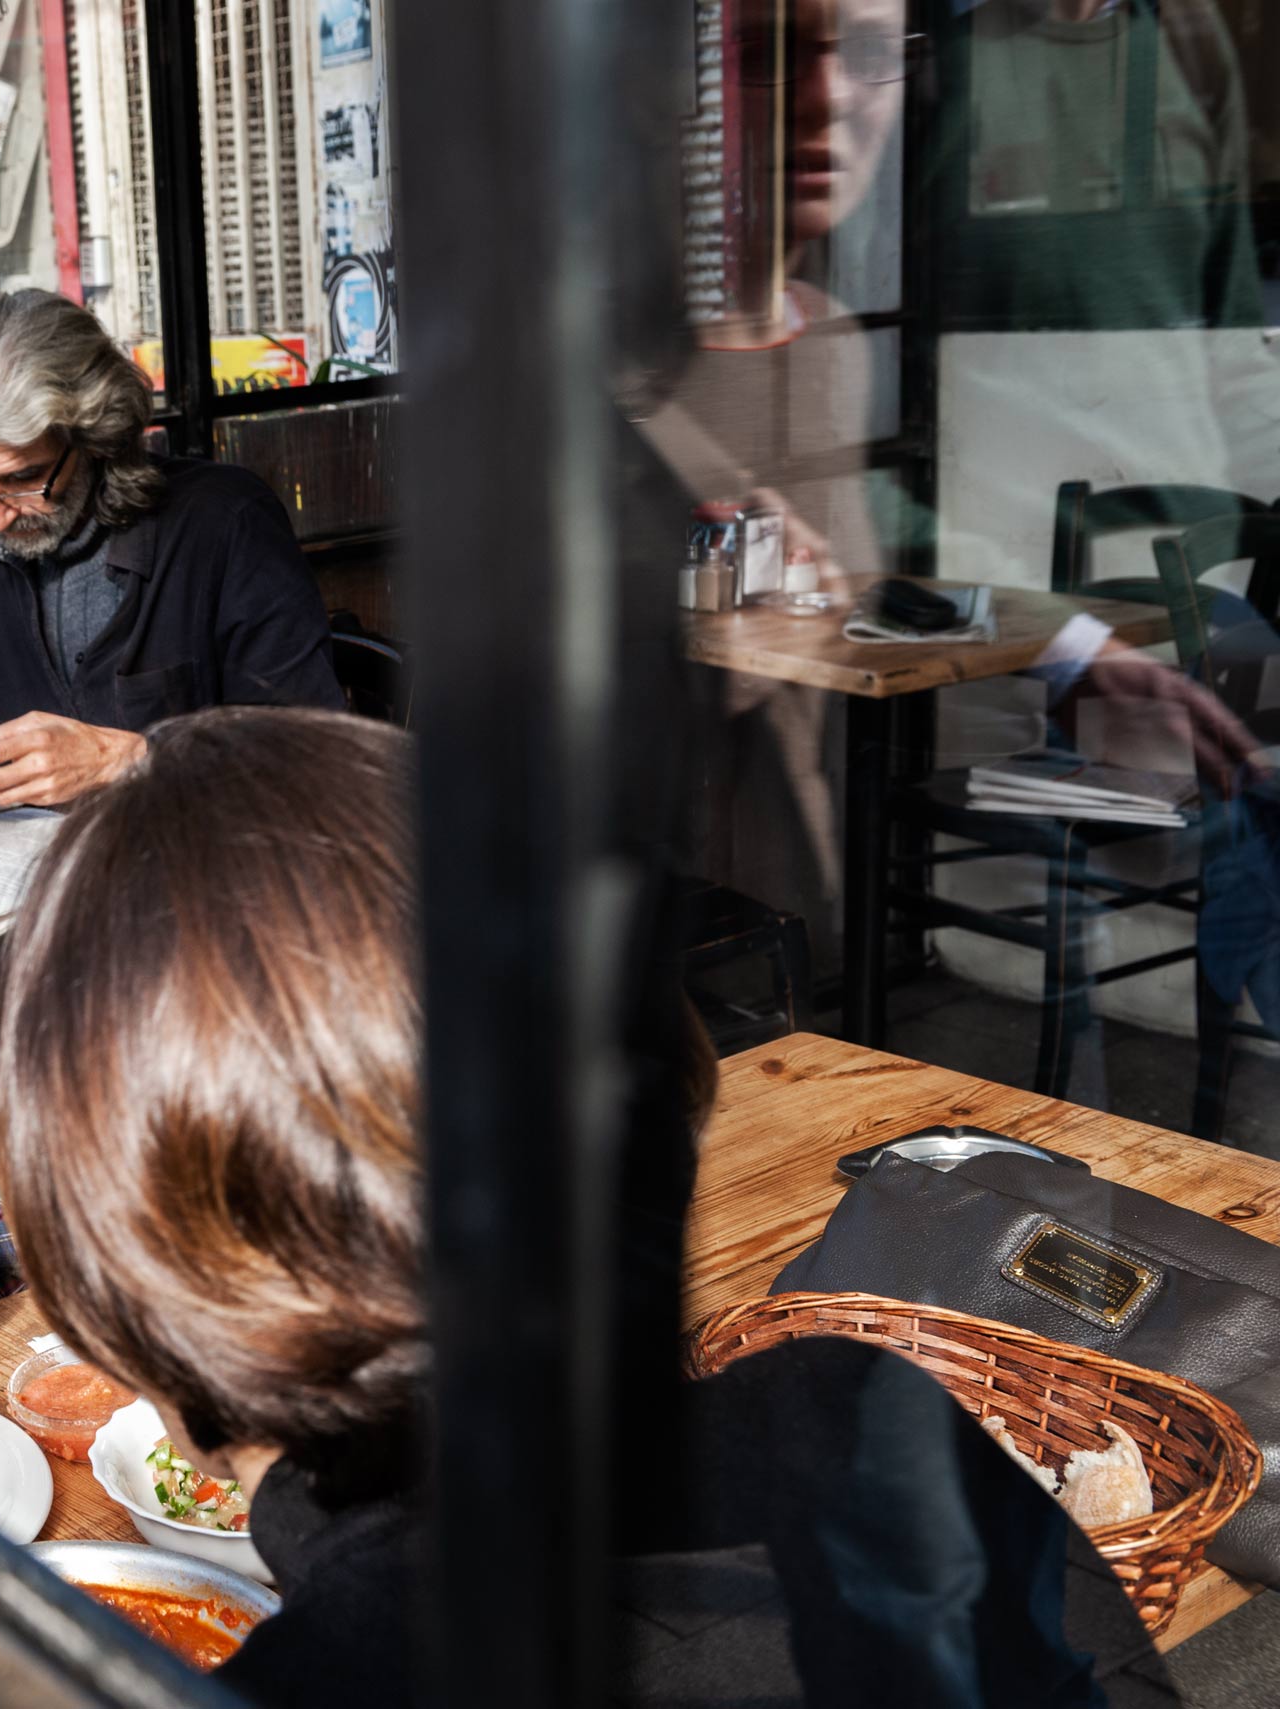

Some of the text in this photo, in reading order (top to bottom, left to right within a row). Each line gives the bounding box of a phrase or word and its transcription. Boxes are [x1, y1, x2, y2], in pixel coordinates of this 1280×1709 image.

[1029, 1257, 1056, 1274] JACOBS
[1059, 1272, 1080, 1287] MARC
[1095, 1290, 1116, 1305] MARC
